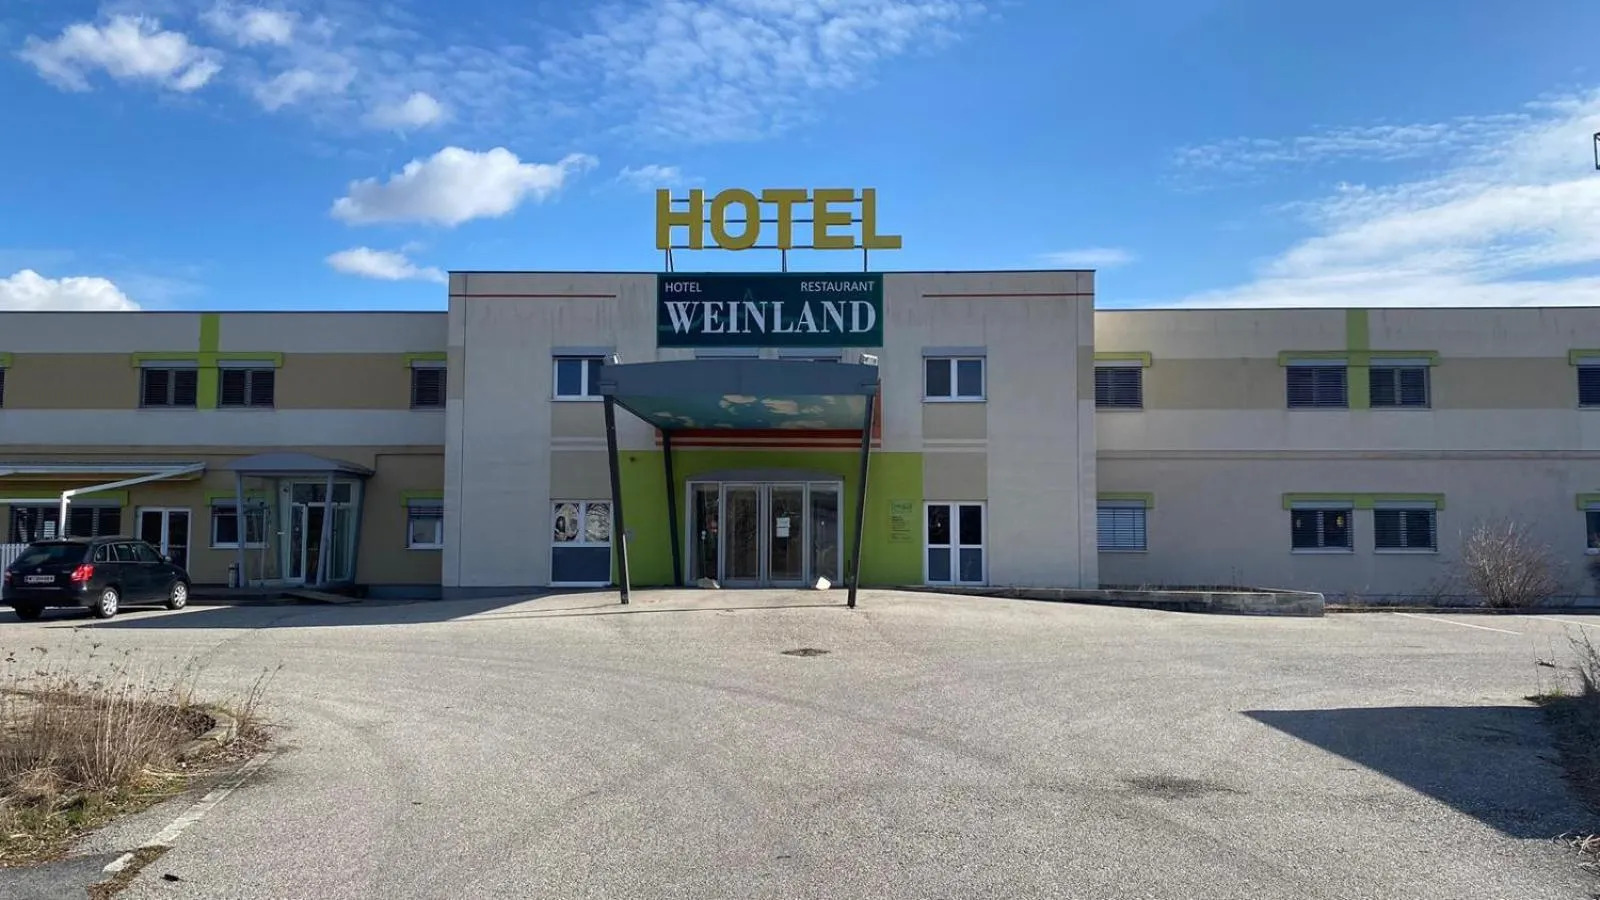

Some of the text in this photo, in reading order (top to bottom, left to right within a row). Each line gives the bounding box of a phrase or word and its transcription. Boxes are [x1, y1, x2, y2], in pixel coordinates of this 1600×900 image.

[656, 188, 902, 250] HOTEL
[664, 281, 875, 293] HOTEL RESTAURANT
[664, 301, 876, 334] WEINLAND
